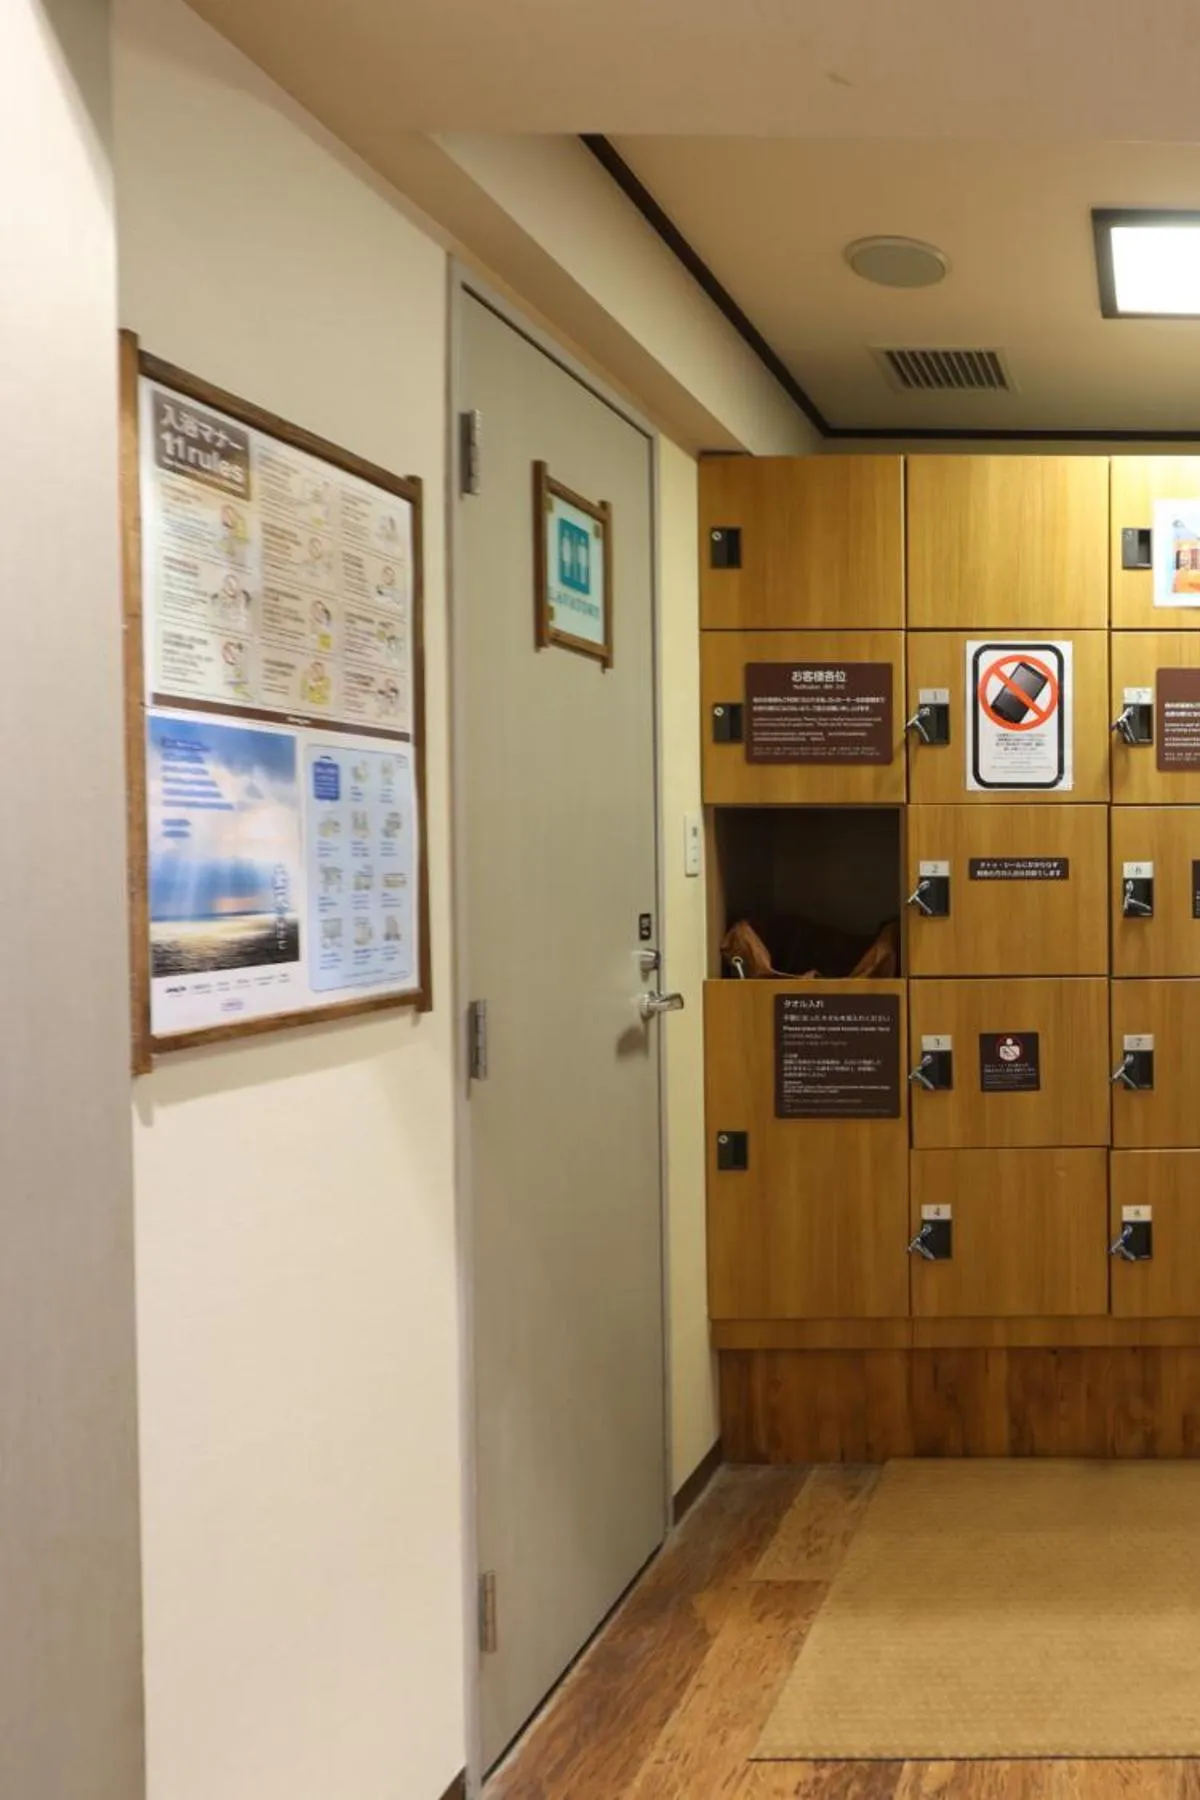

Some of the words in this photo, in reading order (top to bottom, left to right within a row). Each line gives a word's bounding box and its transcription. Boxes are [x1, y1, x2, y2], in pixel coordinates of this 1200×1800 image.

[791, 670, 847, 683] お客様各位
